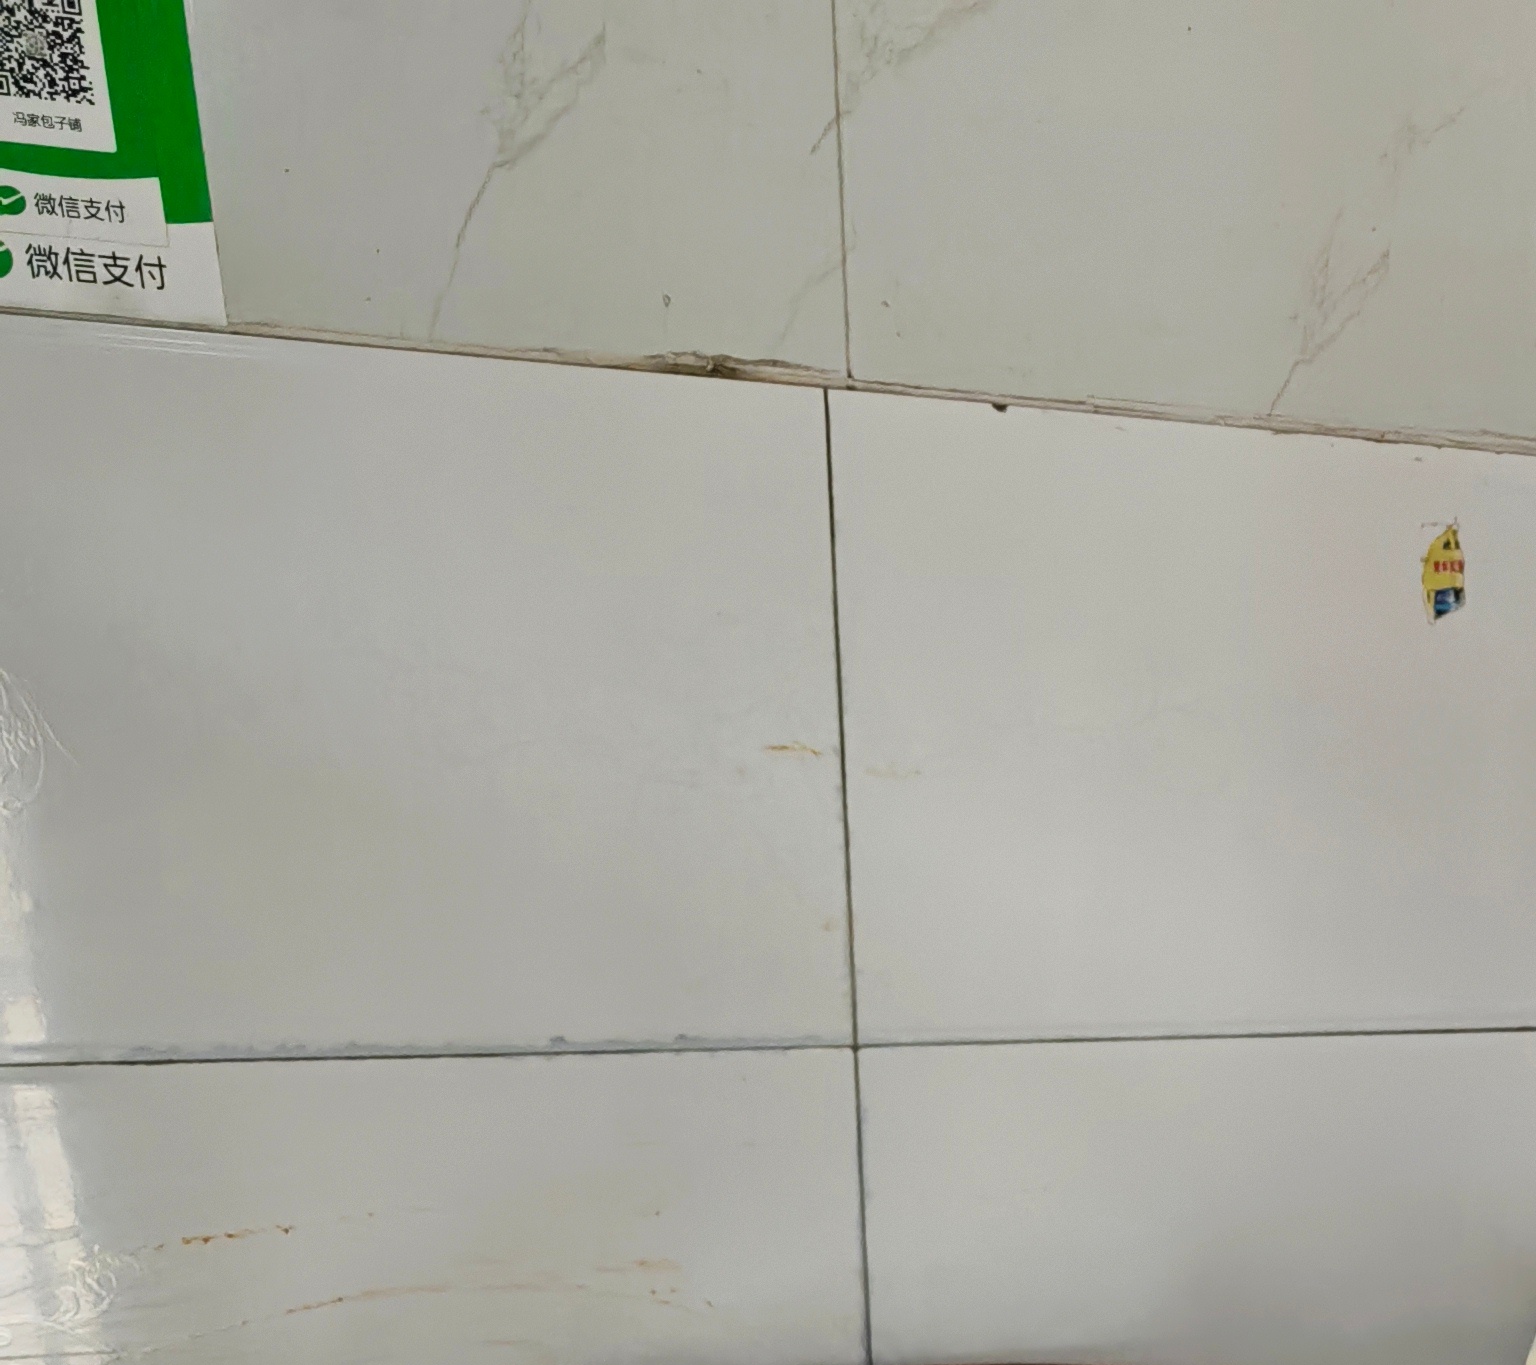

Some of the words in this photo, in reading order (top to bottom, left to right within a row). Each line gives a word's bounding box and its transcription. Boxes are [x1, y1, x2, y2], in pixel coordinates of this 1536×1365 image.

[34, 192, 125, 223] 微信支付
[25, 243, 167, 290] 微信支付
